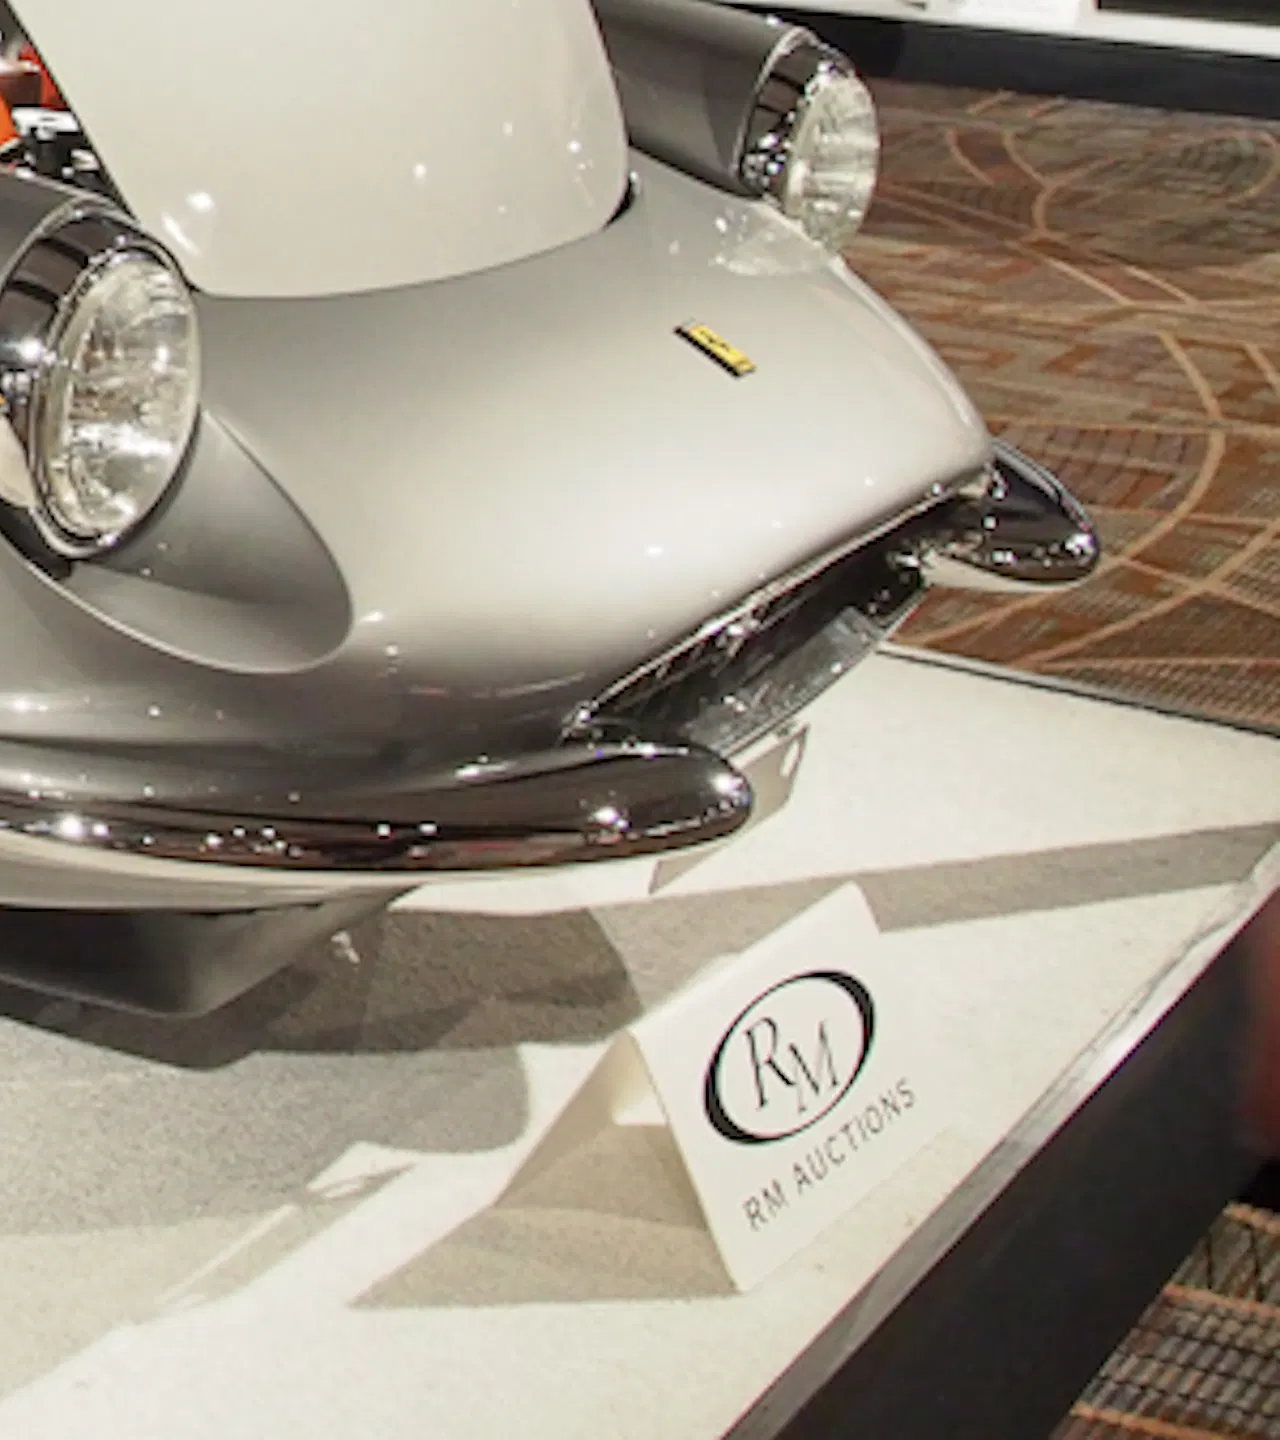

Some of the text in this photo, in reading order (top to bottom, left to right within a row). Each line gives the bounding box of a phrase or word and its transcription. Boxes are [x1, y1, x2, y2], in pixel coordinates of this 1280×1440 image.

[743, 1016, 840, 1115] RM
[742, 1076, 917, 1232] RM AUCTIONS
